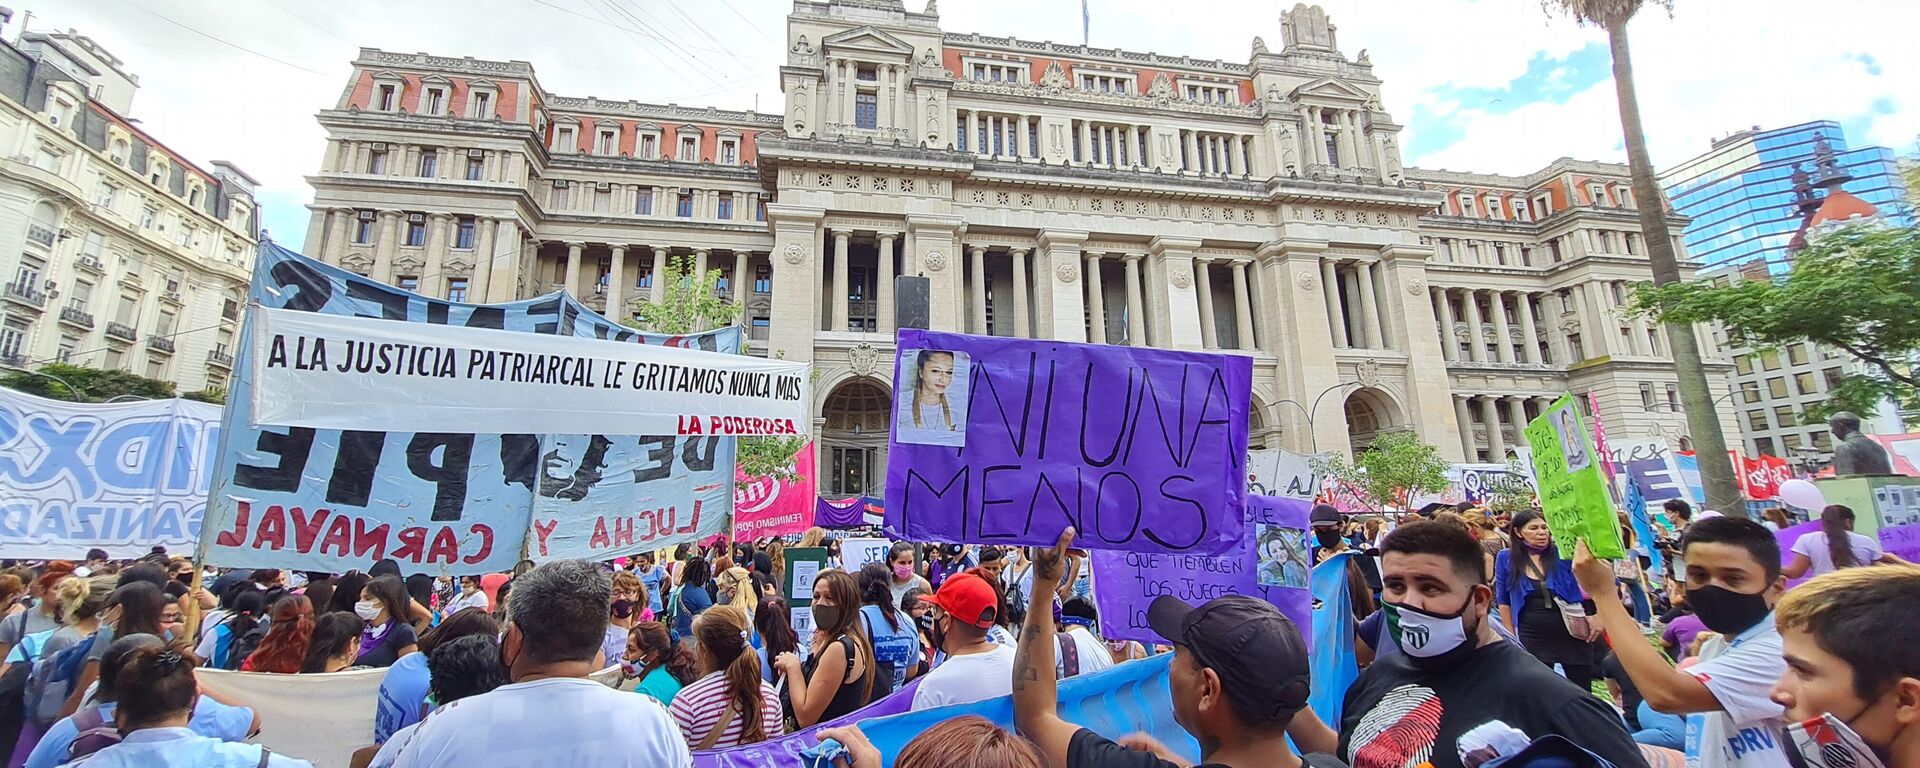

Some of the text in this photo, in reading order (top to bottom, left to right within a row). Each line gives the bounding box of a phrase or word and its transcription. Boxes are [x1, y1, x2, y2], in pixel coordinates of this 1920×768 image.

[267, 334, 802, 402] A LA JUSTICIA PATRIARCAL LE GRITAMOS NUNCA MÁS
[957, 347, 1238, 469] NI UNA
[677, 415, 798, 436] LA PODEROSA
[902, 464, 1208, 550] MENOS
[1126, 552, 1243, 579] QUE TIEMBLEN
[1138, 577, 1173, 598] LOS
[1179, 578, 1241, 601] JUECES
[1128, 604, 1151, 630] LO
